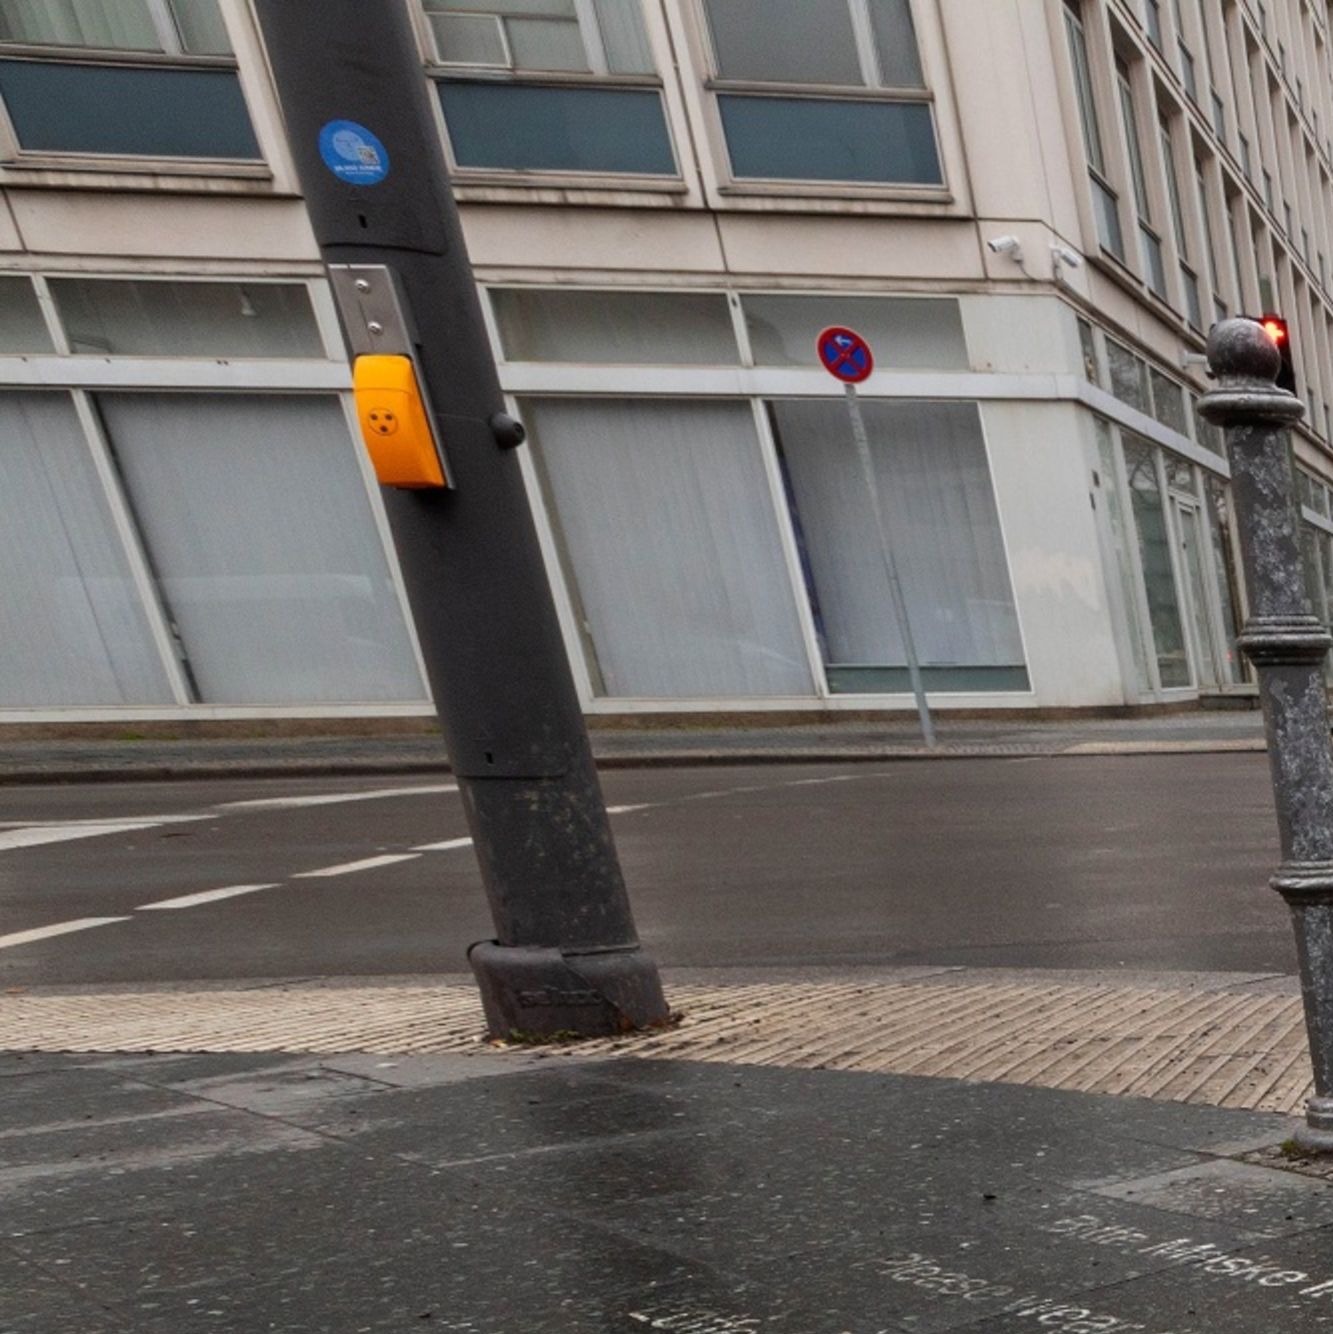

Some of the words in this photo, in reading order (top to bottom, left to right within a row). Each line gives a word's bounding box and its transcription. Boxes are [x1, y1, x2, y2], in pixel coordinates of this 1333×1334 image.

[876, 1252, 1014, 1301] Please
[1043, 1214, 1148, 1245] Bitte
[1138, 1238, 1308, 1287] Maske
